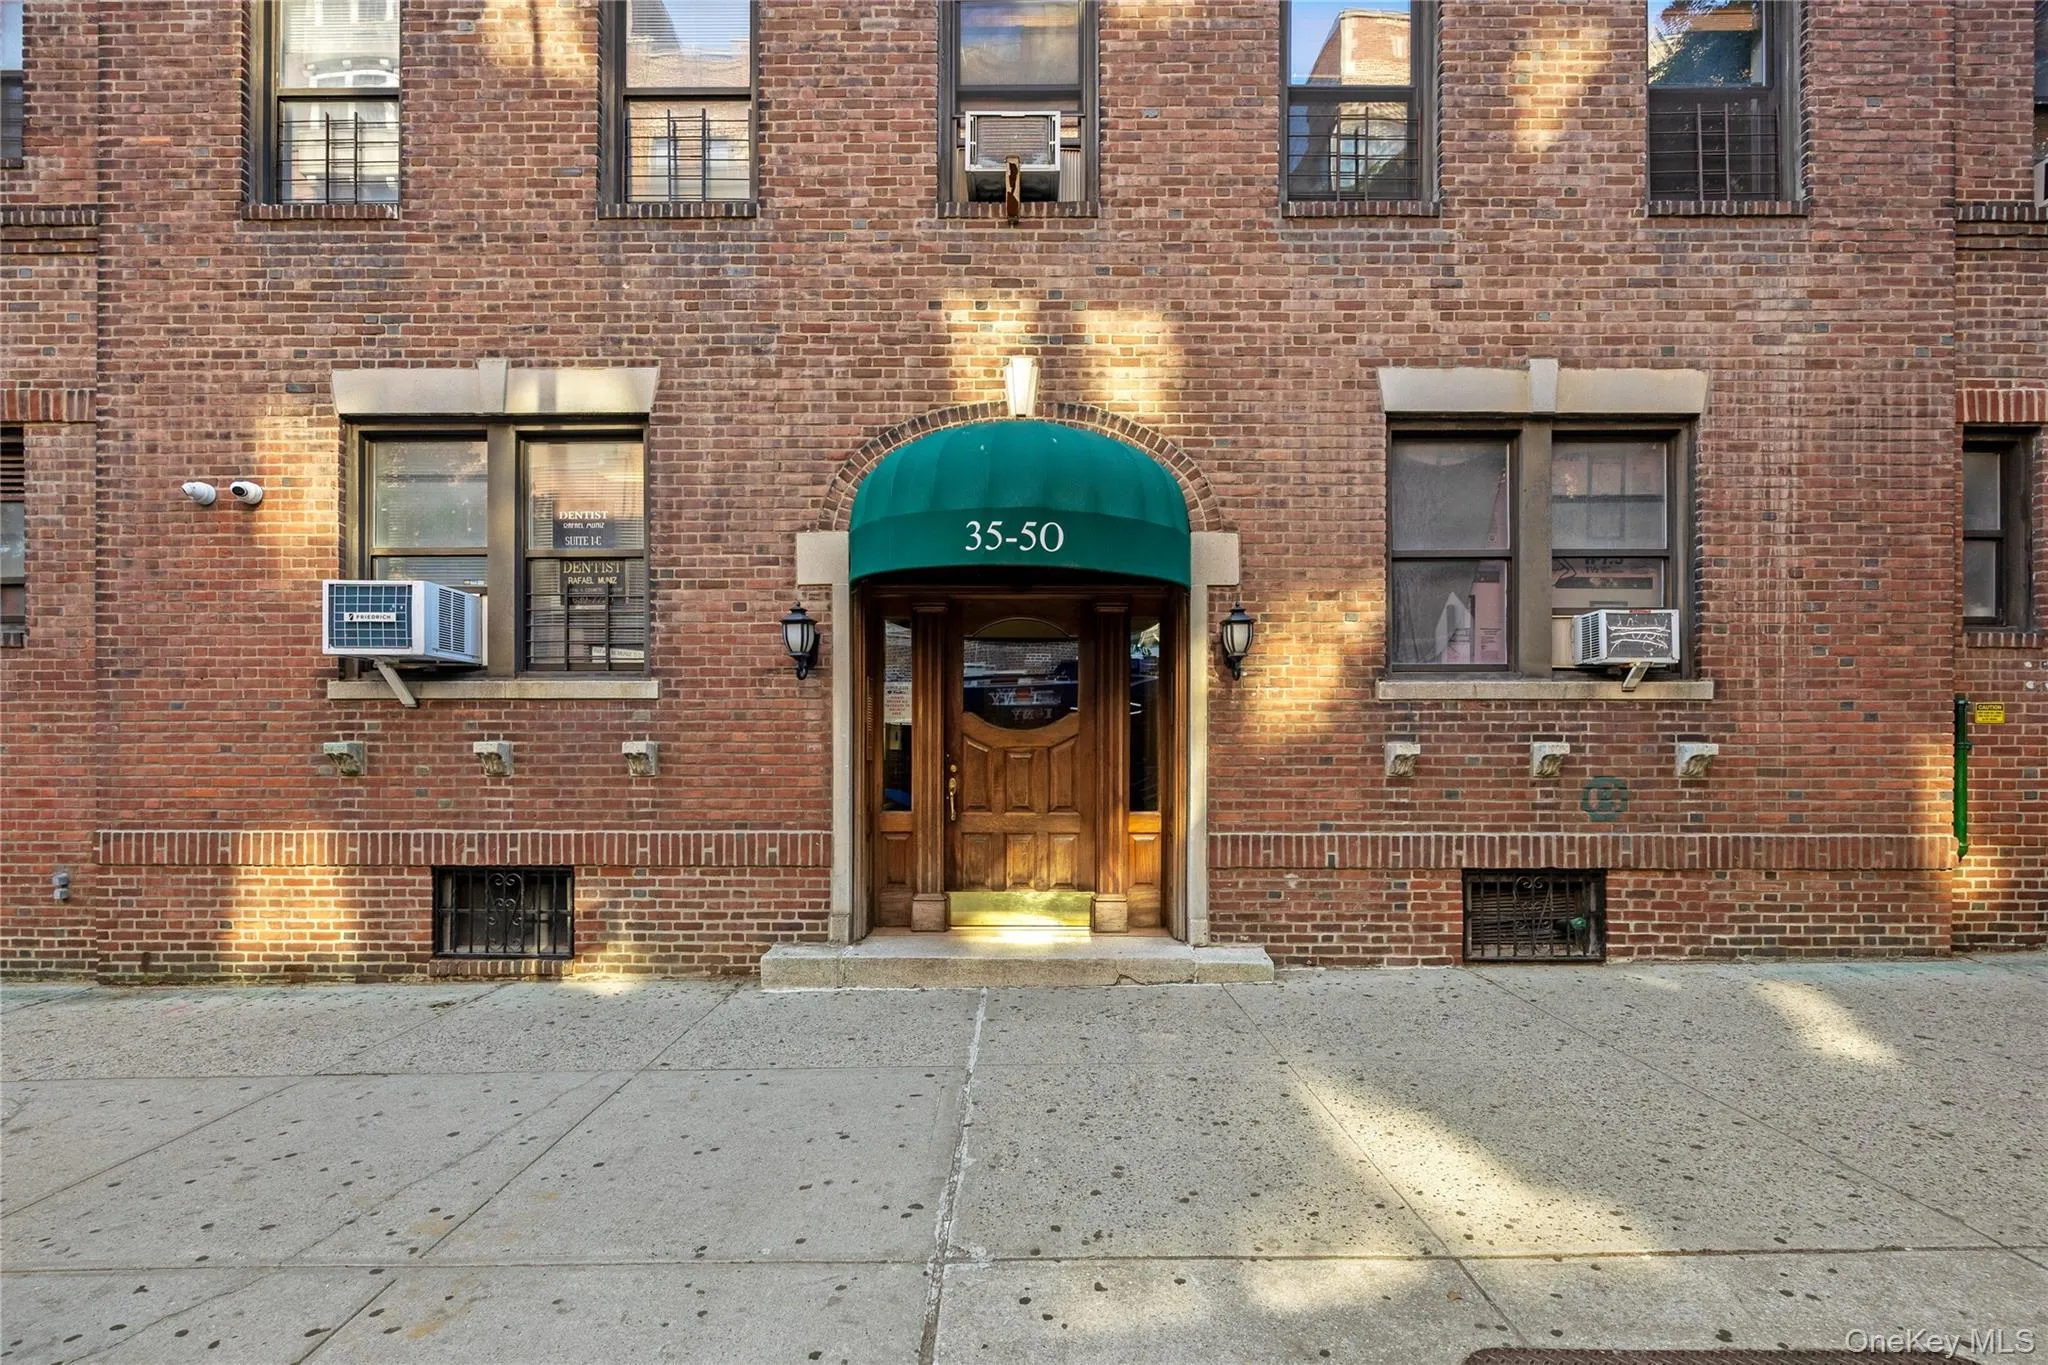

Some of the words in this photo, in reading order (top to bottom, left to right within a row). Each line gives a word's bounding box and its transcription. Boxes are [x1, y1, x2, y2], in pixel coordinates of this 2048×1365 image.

[559, 511, 608, 520] DENTIST
[565, 536, 589, 546] SUITE
[965, 521, 1064, 552] 35-50
[563, 561, 621, 573] DENTIST
[568, 576, 593, 584] RAFAEL
